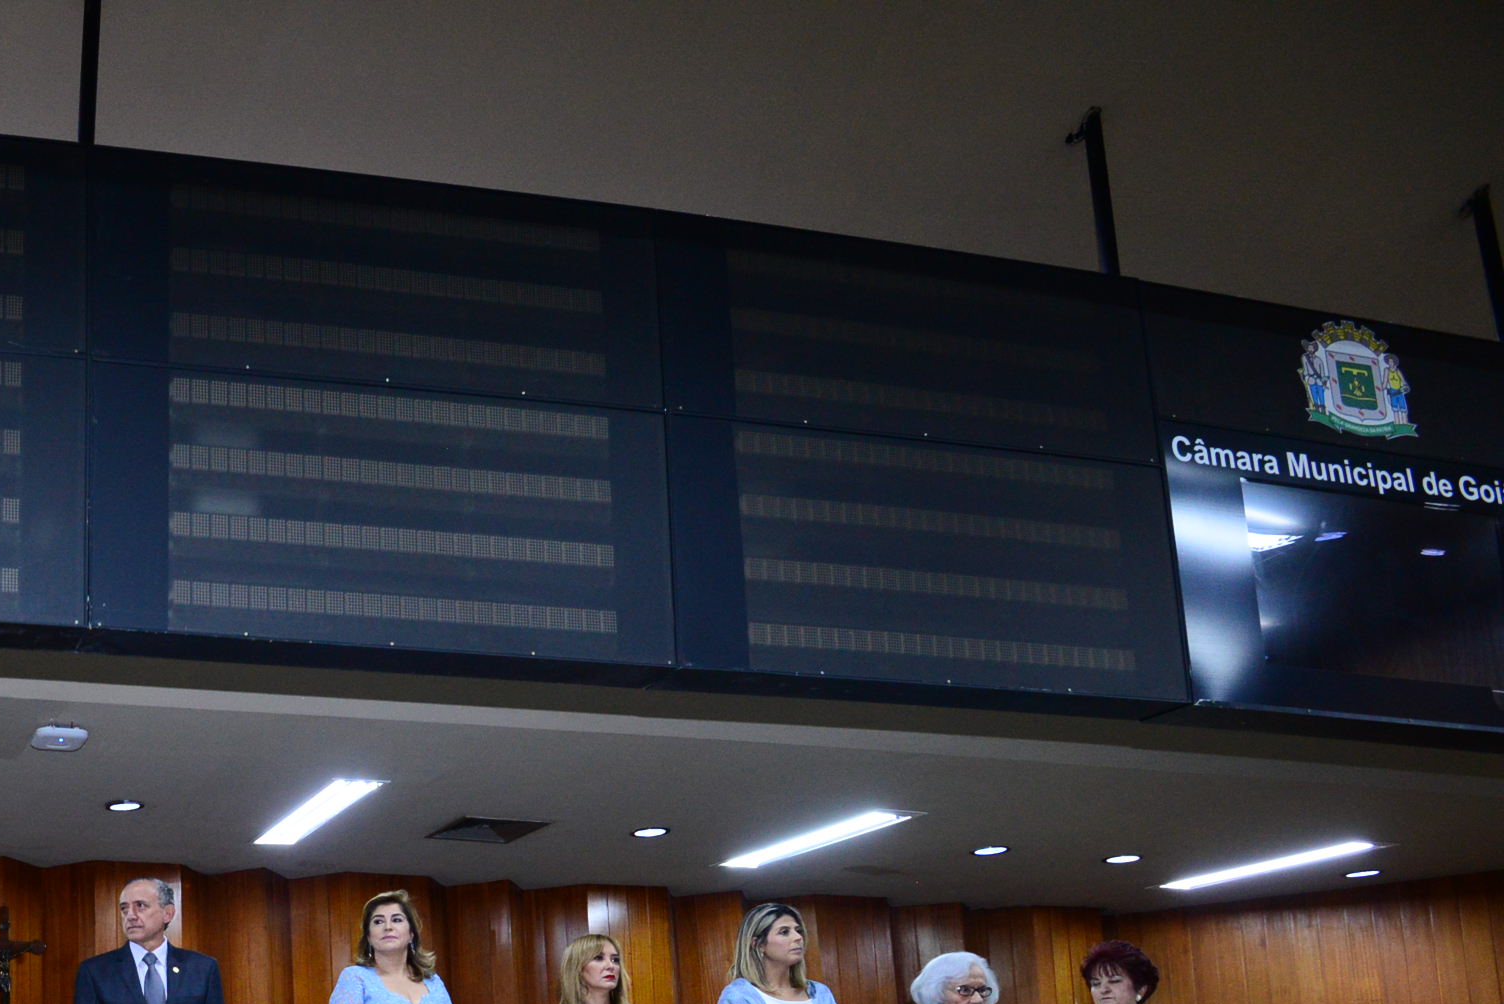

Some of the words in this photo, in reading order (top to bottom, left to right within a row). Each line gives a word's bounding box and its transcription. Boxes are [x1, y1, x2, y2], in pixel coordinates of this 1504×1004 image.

[1172, 435, 1279, 475] Câmara
[1286, 451, 1415, 494] Municipal
[1422, 471, 1453, 498] de
[1458, 475, 1504, 504] Goi
